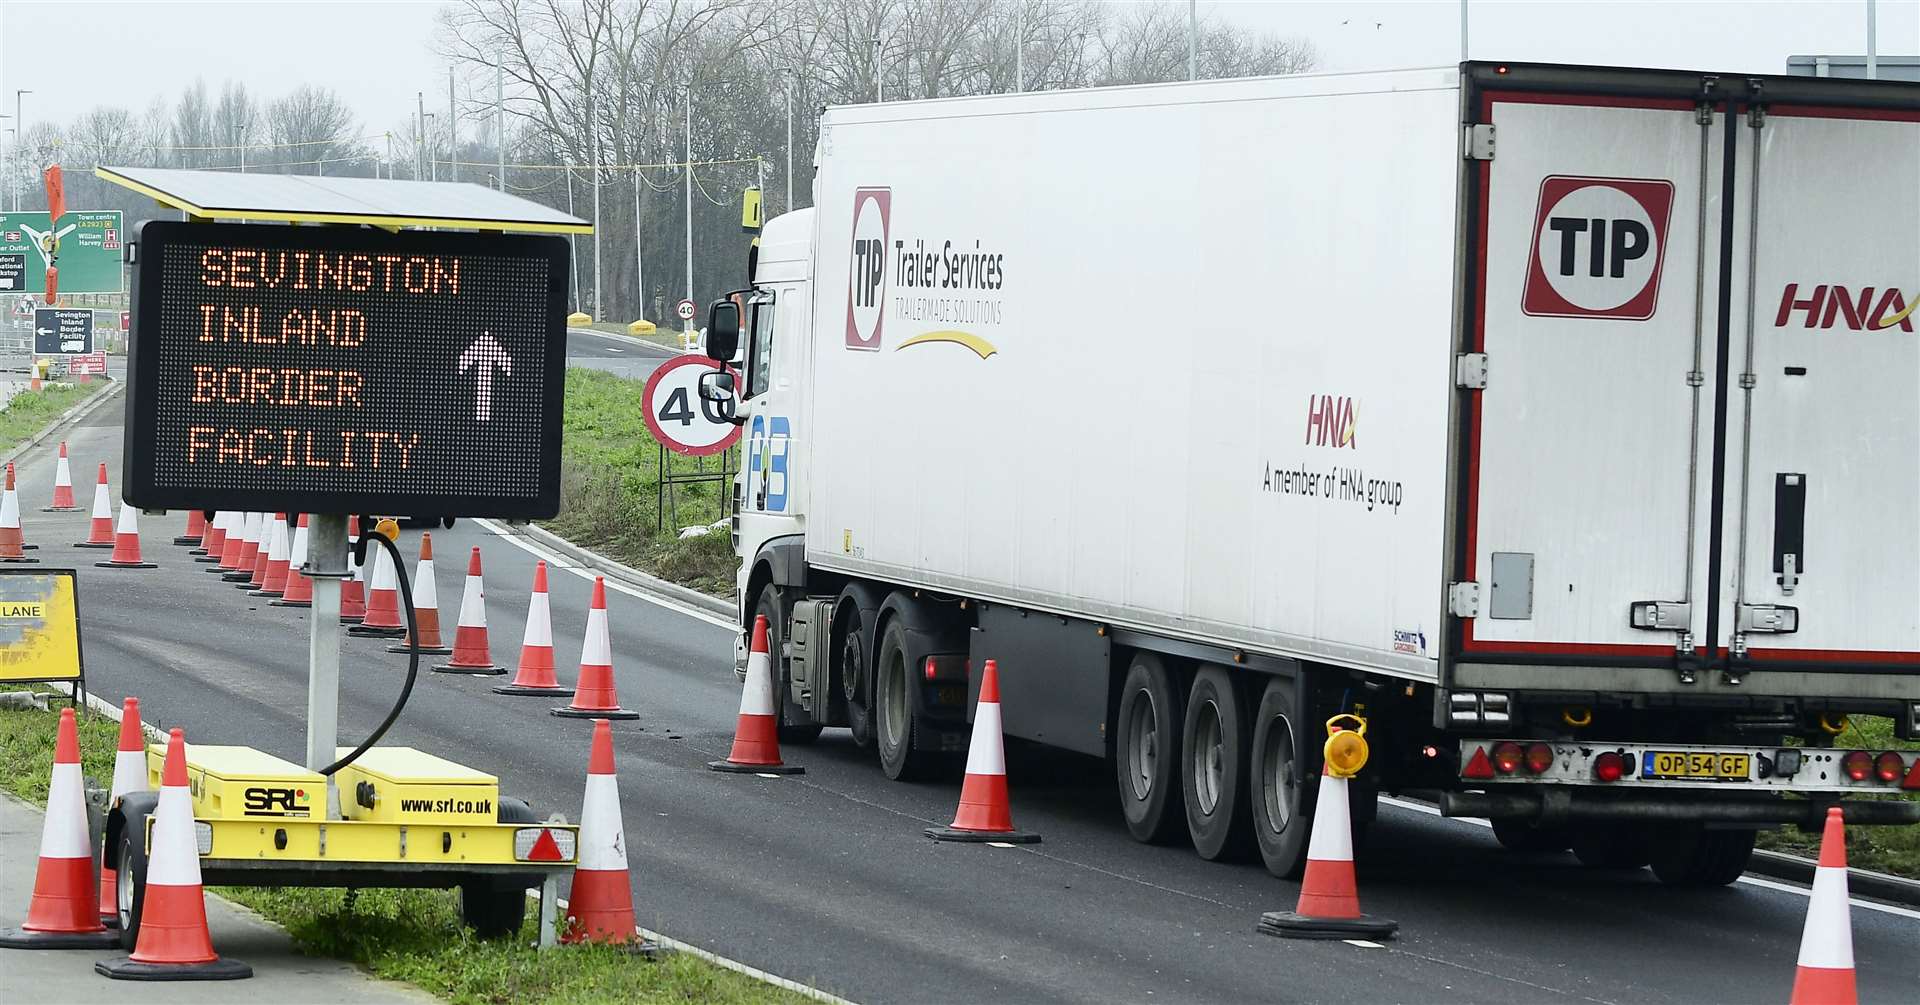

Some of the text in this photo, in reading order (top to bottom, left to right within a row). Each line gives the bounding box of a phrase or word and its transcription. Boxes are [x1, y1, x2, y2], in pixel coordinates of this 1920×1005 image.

[896, 238, 1003, 290] Trailer Services
[1549, 217, 1650, 278] TIP
[201, 249, 460, 295] SEVINGTON
[855, 239, 883, 308] TIP
[55, 311, 90, 319] Sevington
[198, 304, 367, 348] INLAND
[680, 306, 693, 315] 40
[895, 297, 1002, 325] TRAILERMADE SOLUTIONS
[1774, 282, 1916, 333] HNA
[192, 366, 365, 408] BORDER
[1305, 394, 1359, 450] HNA
[188, 426, 420, 469] FACILITY
[1263, 460, 1403, 515] A member of HNA group
[2, 606, 41, 617] LANE
[1691, 757, 1713, 773] 54
[1721, 757, 1744, 774] GF
[244, 787, 310, 811] SRL
[401, 798, 491, 814] www.srl.co.uk
